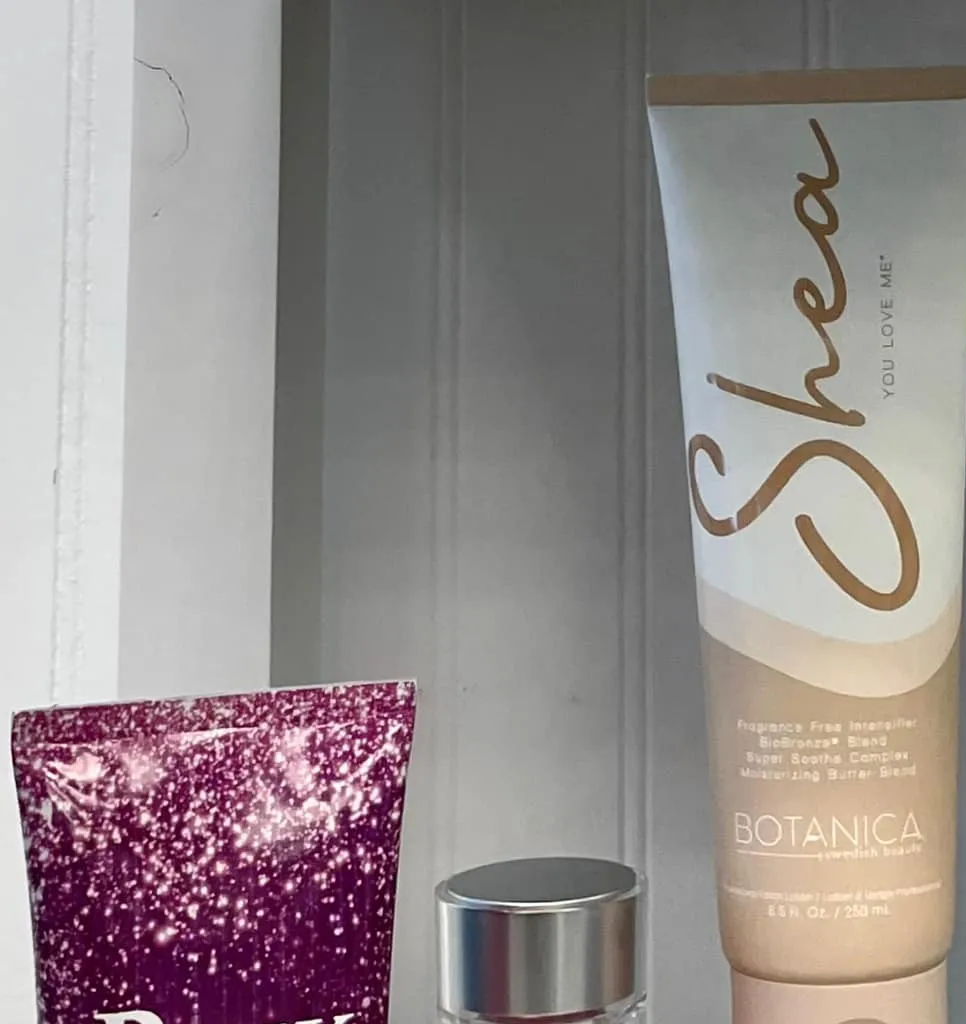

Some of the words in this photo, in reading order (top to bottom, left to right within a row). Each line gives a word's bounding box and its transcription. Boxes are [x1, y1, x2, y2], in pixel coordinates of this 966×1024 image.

[880, 300, 894, 348] LOVE
[688, 117, 920, 612] Shea
[881, 359, 896, 400] YOU
[737, 720, 803, 734] Fragrance
[810, 721, 842, 732] Free
[849, 718, 917, 731] Intensifier
[847, 736, 888, 747] Blend
[746, 752, 783, 764] Super
[790, 753, 842, 764] Soothe
[849, 752, 909, 764] Complex
[828, 768, 872, 780] Butter
[734, 811, 926, 848] BOTANICA
